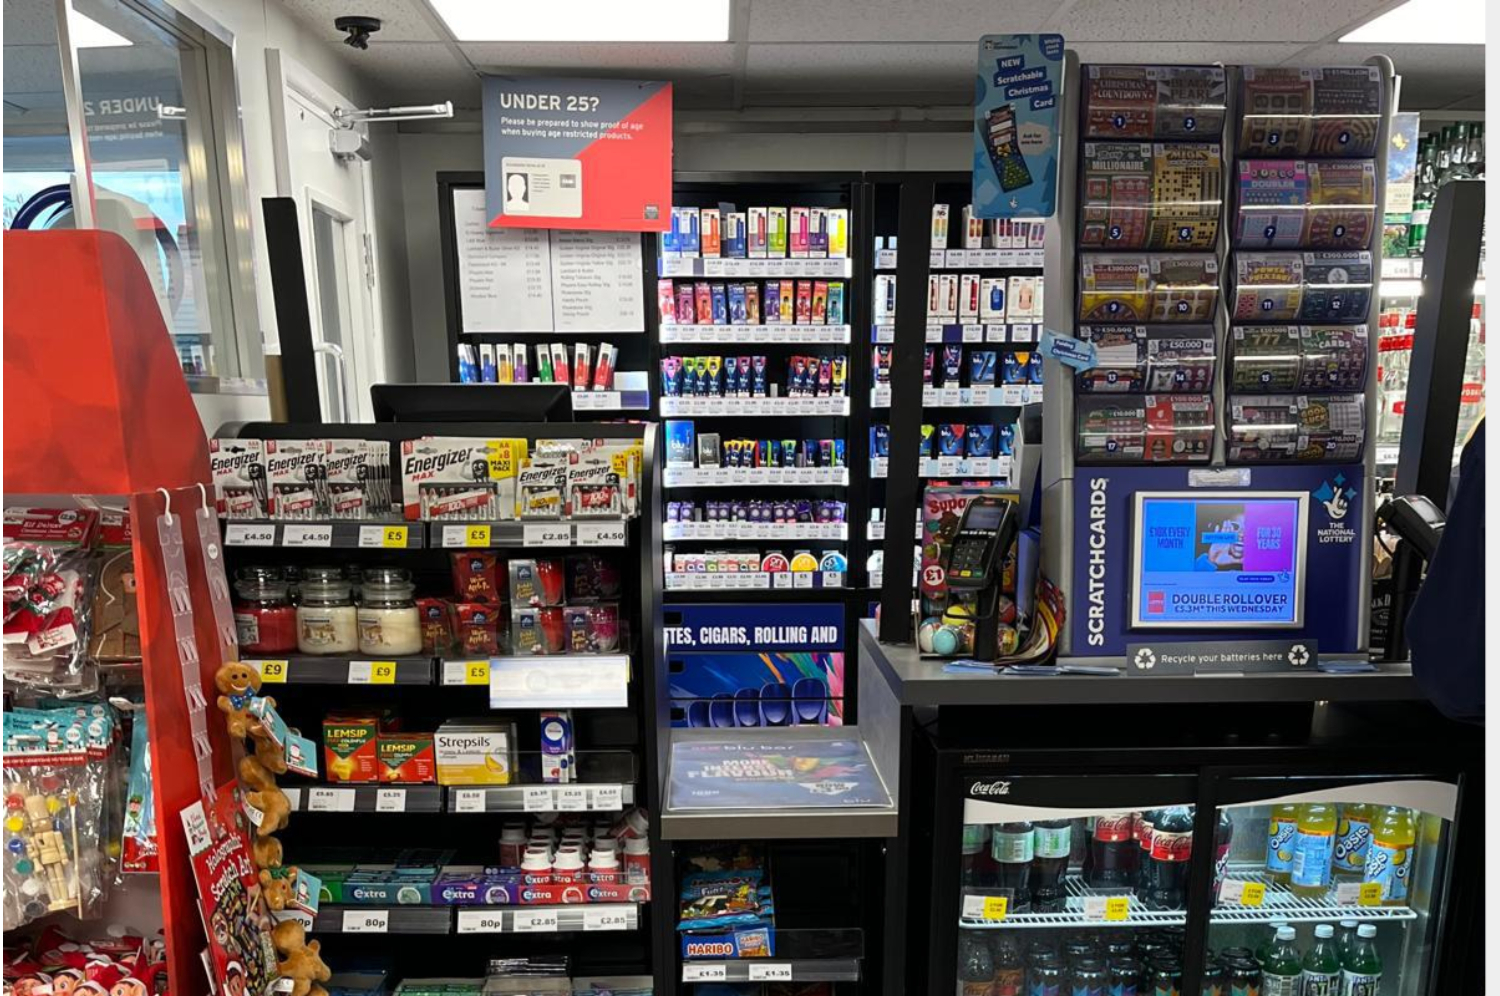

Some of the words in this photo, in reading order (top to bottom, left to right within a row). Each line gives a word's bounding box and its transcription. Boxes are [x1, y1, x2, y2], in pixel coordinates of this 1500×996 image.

[1001, 58, 1021, 69] NEW
[997, 70, 1043, 86] Scratchable
[1008, 83, 1049, 97] Christmas
[500, 93, 561, 110] UNDER
[566, 96, 600, 112] 25?
[1033, 97, 1054, 109] Card
[501, 117, 525, 126] Please
[527, 118, 536, 126] be
[537, 119, 570, 131] prepared
[571, 120, 579, 128] to
[580, 120, 599, 128] show
[601, 121, 620, 132] proof
[621, 122, 630, 130] of
[630, 124, 644, 132] age
[1117, 116, 1122, 125] 1
[1186, 119, 1193, 128] 2
[501, 127, 521, 135] when
[522, 128, 547, 138] buying
[548, 130, 561, 138] age
[562, 130, 598, 139] restricted
[599, 132, 633, 140] products.
[1340, 133, 1348, 142] 4
[1112, 228, 1119, 237] 5
[1181, 228, 1188, 237] 6
[1267, 229, 1273, 237] 7
[1336, 226, 1343, 235] 8
[1111, 303, 1117, 311] 9
[1178, 303, 1188, 311] 10
[1263, 301, 1272, 309] 11
[1332, 300, 1341, 309] 12
[671, 439, 685, 449] blu
[1107, 443, 1116, 452] 17
[1326, 441, 1337, 449] 20
[212, 452, 260, 471] Energizer
[268, 452, 317, 472] Energizer
[405, 447, 473, 474] Energizer
[217, 468, 233, 476] MAX
[273, 469, 290, 477] MAX
[328, 469, 343, 477] MAX
[412, 471, 435, 482] MAX
[519, 466, 567, 482] Energizer
[569, 466, 611, 480] Energizer
[1329, 522, 1344, 530] THE
[244, 533, 272, 541] £4.50
[302, 533, 330, 542] £4.50
[387, 531, 402, 541] £5
[471, 531, 486, 541] £5
[542, 532, 570, 541] £2.85
[596, 532, 624, 541] £4.50
[1317, 528, 1356, 537] NATIONAL
[1157, 538, 1184, 549] MONTH
[1257, 538, 1281, 550] YEARS
[1319, 535, 1354, 544] LOTTERY
[1088, 478, 1107, 647] SCRATCHCARDS
[925, 570, 943, 582] £1
[1172, 594, 1221, 605] DOUBLE
[1223, 594, 1288, 605] ROLLOVER
[1206, 605, 1226, 613] THIS
[1228, 605, 1284, 613] WEDNESDAY
[700, 626, 751, 646] CIGARS,
[755, 626, 808, 644] ROLLING
[811, 626, 838, 644] AND
[1161, 654, 1197, 664] Recycle
[1199, 655, 1219, 665] your
[1221, 652, 1260, 662] batteries
[1262, 652, 1283, 662] here
[264, 665, 282, 675] £9
[376, 667, 391, 677] £9
[470, 668, 485, 678] £5
[327, 729, 368, 738] LEMSIP
[381, 744, 416, 752] LEMSIP
[439, 737, 491, 749] Strepsils
[970, 781, 1010, 795] Coca-Cola
[1271, 825, 1294, 850] Oasis
[1336, 825, 1369, 859] Oasis
[211, 859, 239, 902] Scratch
[525, 875, 549, 885] extra
[354, 887, 387, 899] extra
[442, 888, 475, 899] extra
[523, 888, 552, 900] extra
[590, 887, 618, 898] extra
[365, 919, 386, 928] 80p
[480, 919, 501, 928] 80p
[531, 918, 556, 926] £2.85
[601, 917, 625, 925] £2.85
[687, 944, 734, 956] HARIBO
